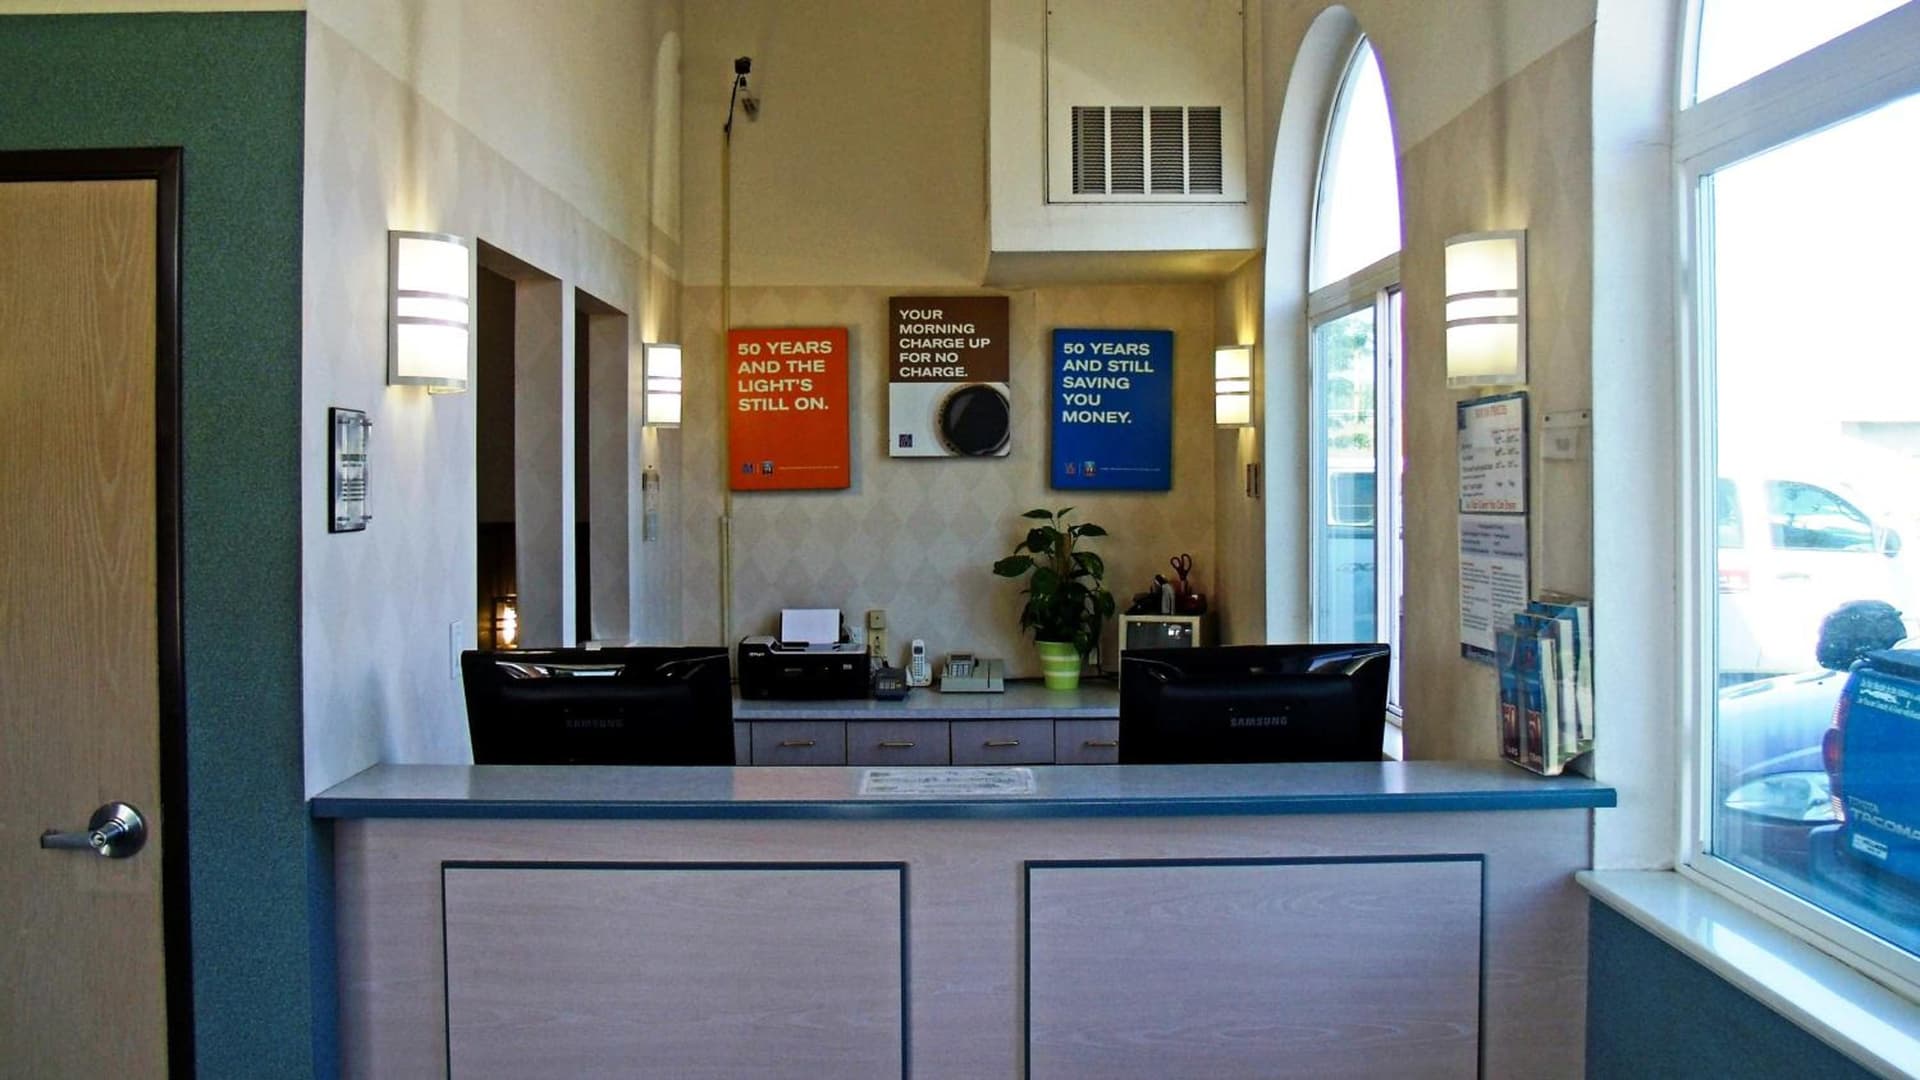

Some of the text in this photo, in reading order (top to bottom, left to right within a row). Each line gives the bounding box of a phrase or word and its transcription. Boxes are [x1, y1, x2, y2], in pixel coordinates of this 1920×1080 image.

[899, 309, 943, 320] YOUR
[899, 323, 976, 334] MORNING
[738, 341, 832, 356] 50 YEARS
[899, 338, 991, 349] CHARGE UP
[1063, 342, 1150, 356] 50 YEARS
[899, 352, 959, 363] FOR NO
[738, 360, 825, 374] AND THE
[899, 366, 969, 377] CHARGE.
[1062, 359, 1155, 373] AND STILL
[738, 378, 814, 393] LIGHT'S
[1062, 376, 1130, 389] SAVING
[738, 397, 829, 411] STILL ON.
[1062, 393, 1101, 406] YOU
[1062, 410, 1132, 424] MONEY.
[1230, 716, 1288, 728] SAMSUNG
